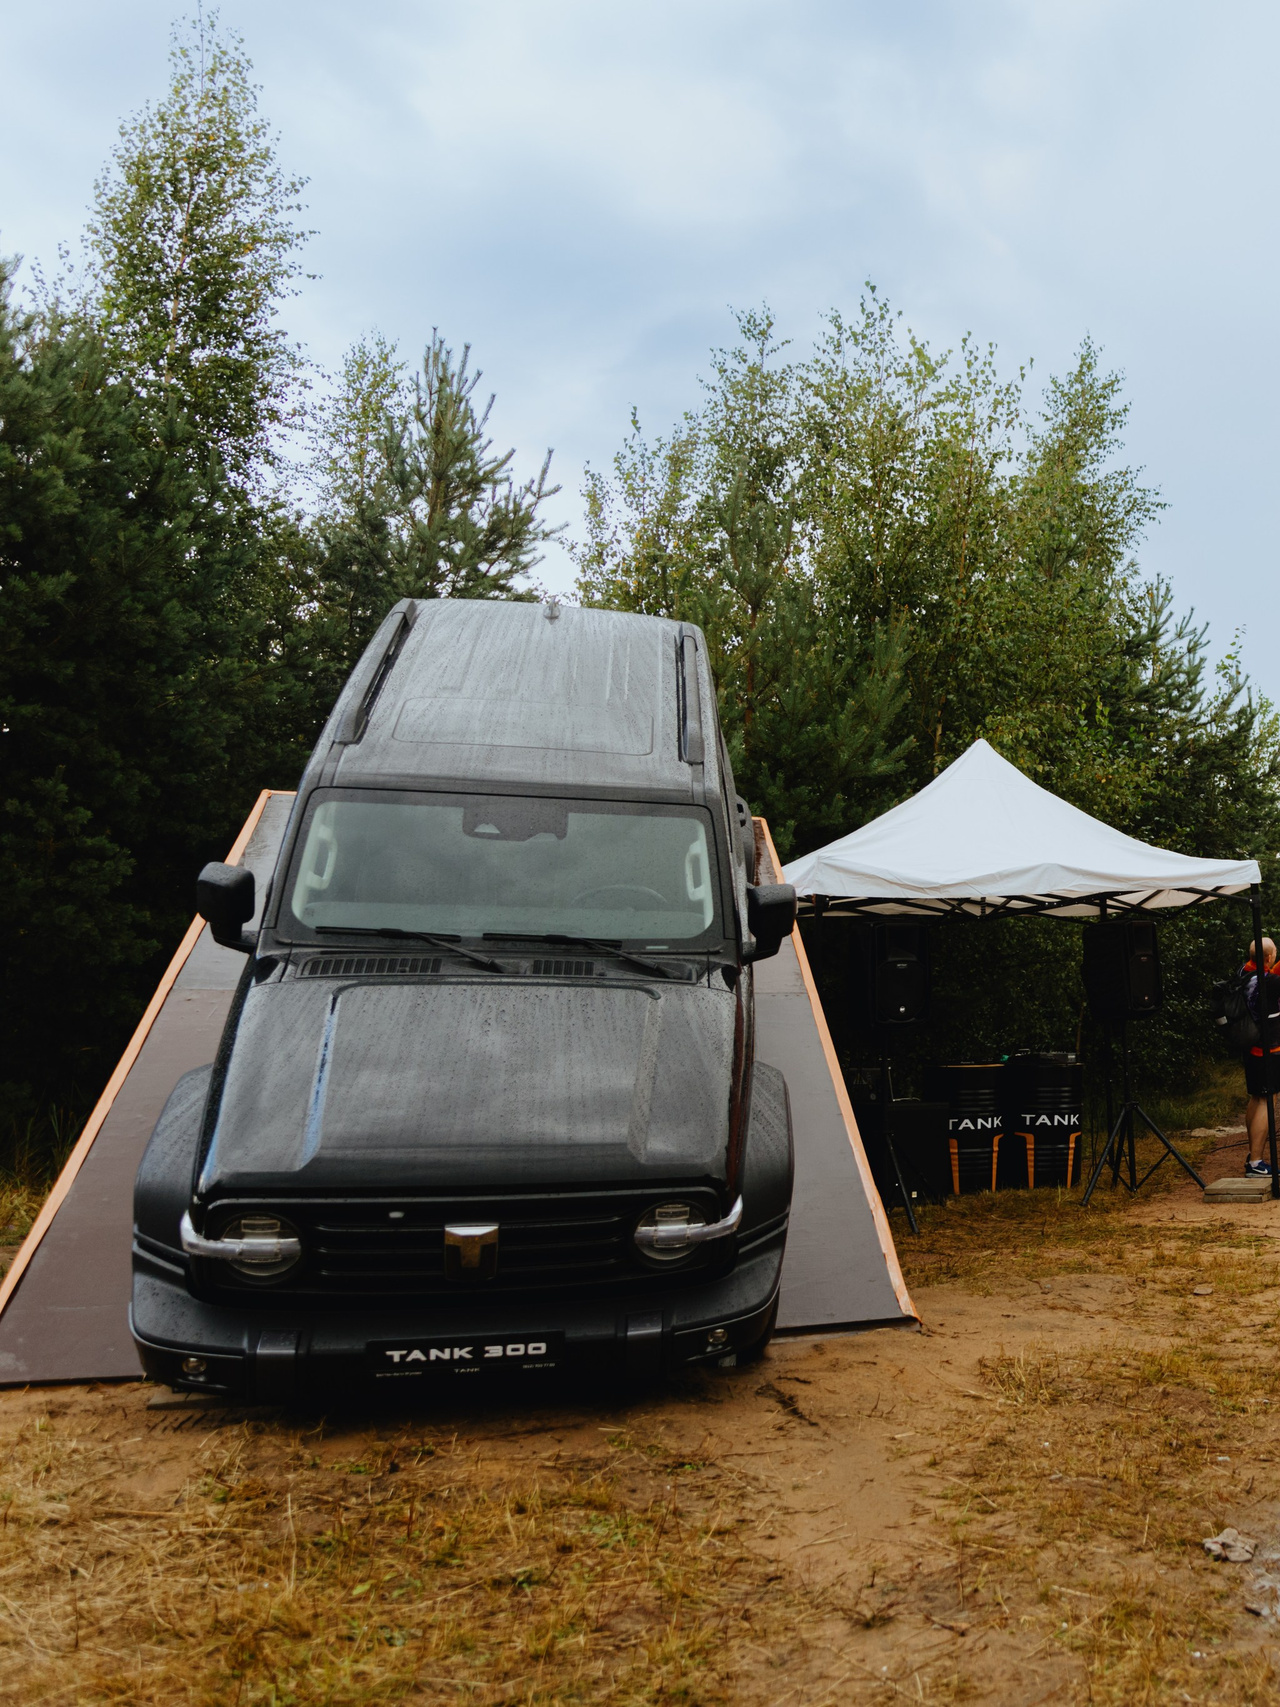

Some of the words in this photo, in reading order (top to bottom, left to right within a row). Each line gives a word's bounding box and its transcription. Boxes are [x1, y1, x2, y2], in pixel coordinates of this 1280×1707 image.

[1021, 1113, 1080, 1126] TANK
[385, 1347, 474, 1363] TANK
[484, 1342, 547, 1358] 300
